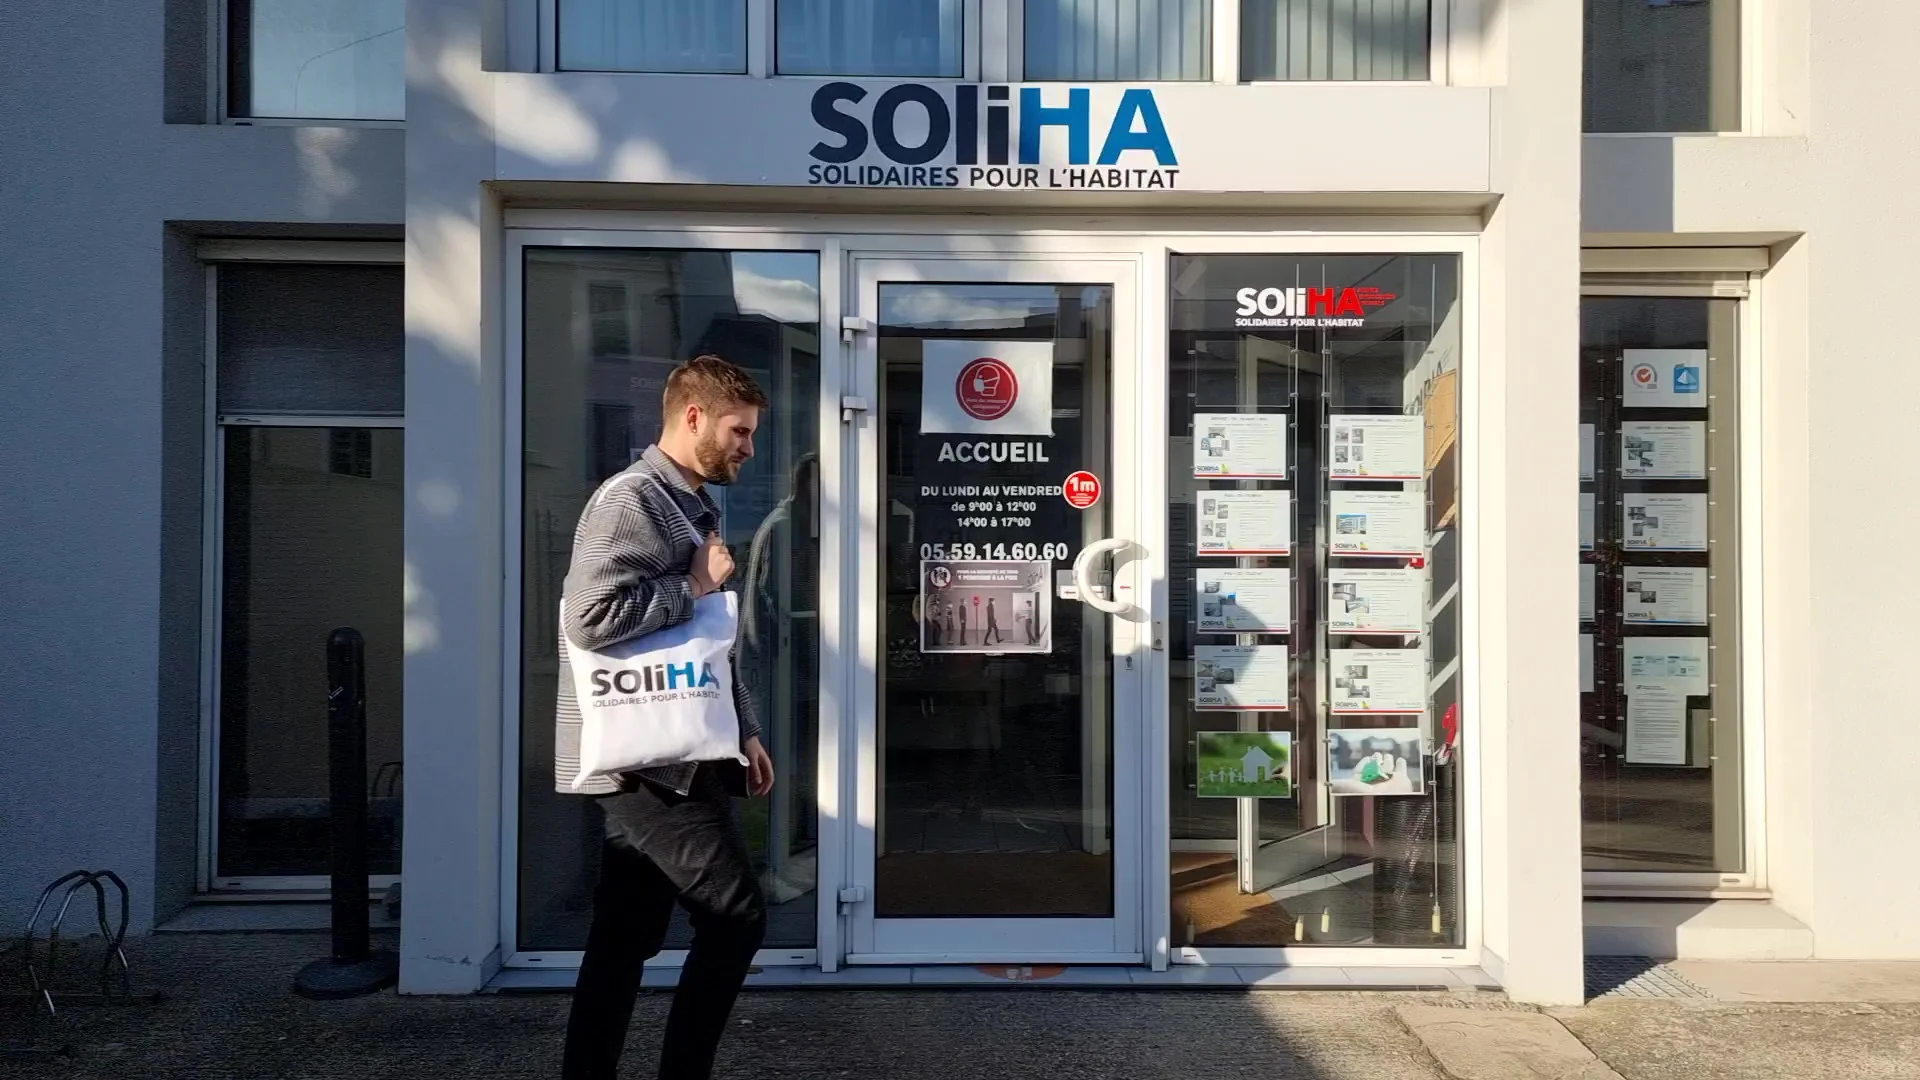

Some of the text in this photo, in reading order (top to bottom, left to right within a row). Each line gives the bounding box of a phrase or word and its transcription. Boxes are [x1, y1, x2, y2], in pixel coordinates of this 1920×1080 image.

[808, 82, 1178, 165] SOliHA
[808, 164, 1180, 189] SOLIDAIRES POUR L'HABITAT
[1235, 318, 1288, 327] SOLIDAIRES
[1290, 318, 1316, 327] POUR
[938, 442, 1049, 462] ACCUEIL
[921, 485, 1063, 496] DU LUNDI AU VENDRED
[1069, 477, 1096, 492] 1m
[951, 501, 966, 512] de
[995, 500, 1003, 512] à
[990, 516, 998, 528] à
[920, 542, 1068, 560] 05.59.14.60.60
[651, 692, 678, 703] POUR
